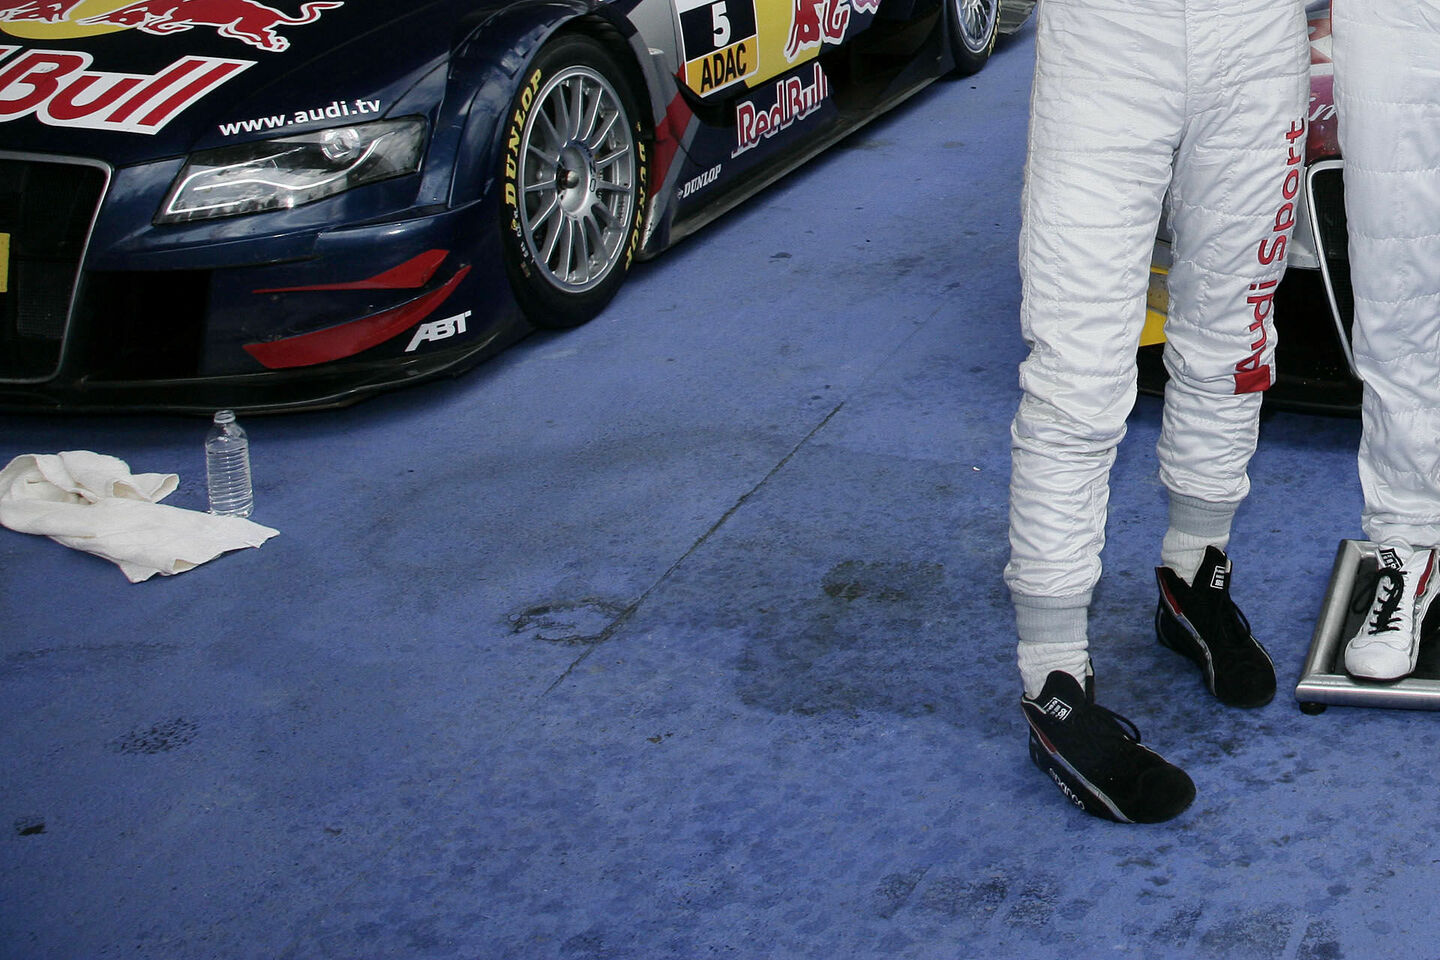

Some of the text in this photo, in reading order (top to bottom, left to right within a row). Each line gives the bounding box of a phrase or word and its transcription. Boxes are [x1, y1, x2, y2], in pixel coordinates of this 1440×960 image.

[711, 1, 732, 48] 5
[700, 42, 748, 93] ADAC
[219, 97, 381, 136] www.audi.tv
[731, 61, 828, 159] Red Bull
[505, 69, 542, 208] DUNLOP
[683, 164, 722, 199] DUNLOP
[1257, 117, 1305, 266] Sport
[404, 310, 472, 353] ABT
[1235, 279, 1278, 372] Audi
